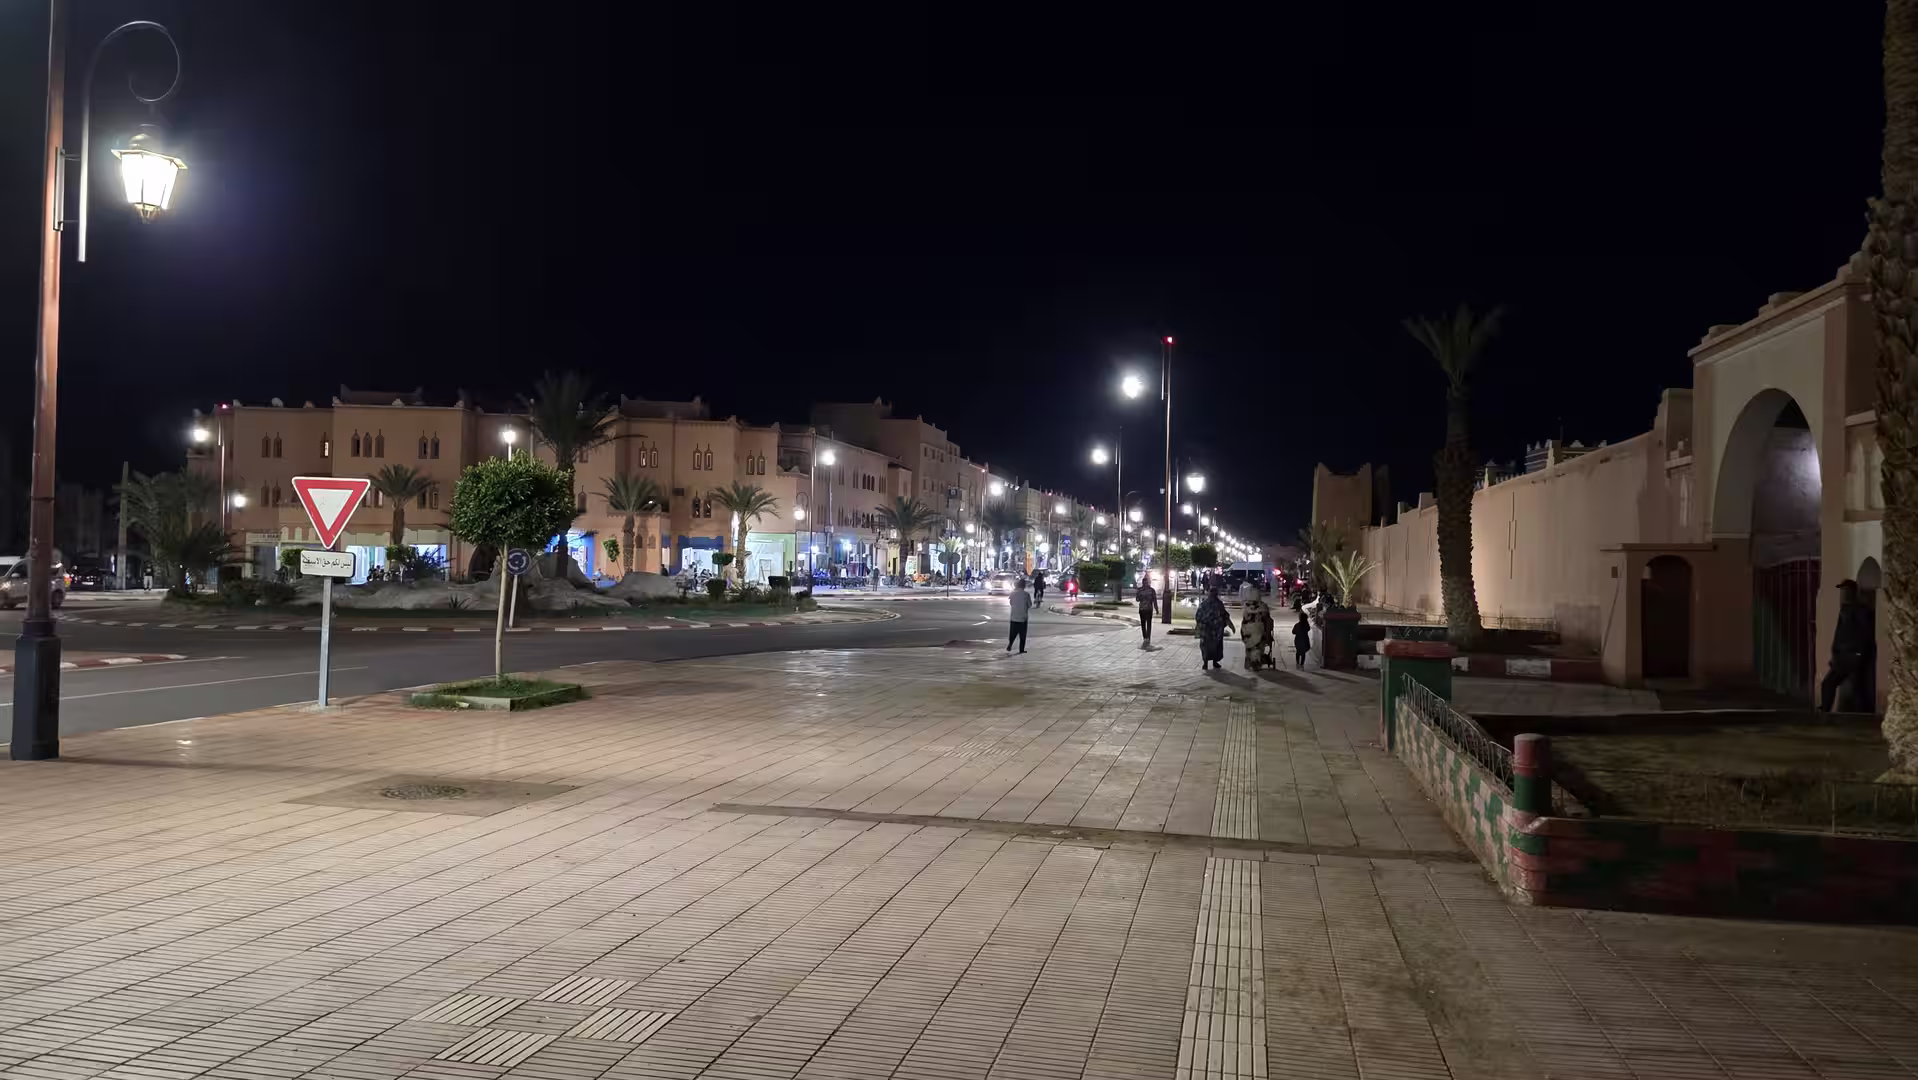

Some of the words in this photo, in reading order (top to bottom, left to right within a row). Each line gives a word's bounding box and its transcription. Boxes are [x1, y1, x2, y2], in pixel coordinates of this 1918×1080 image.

[321, 558, 331, 568] حق
[331, 558, 341, 568] لكم
[340, 559, 352, 569] ليس
